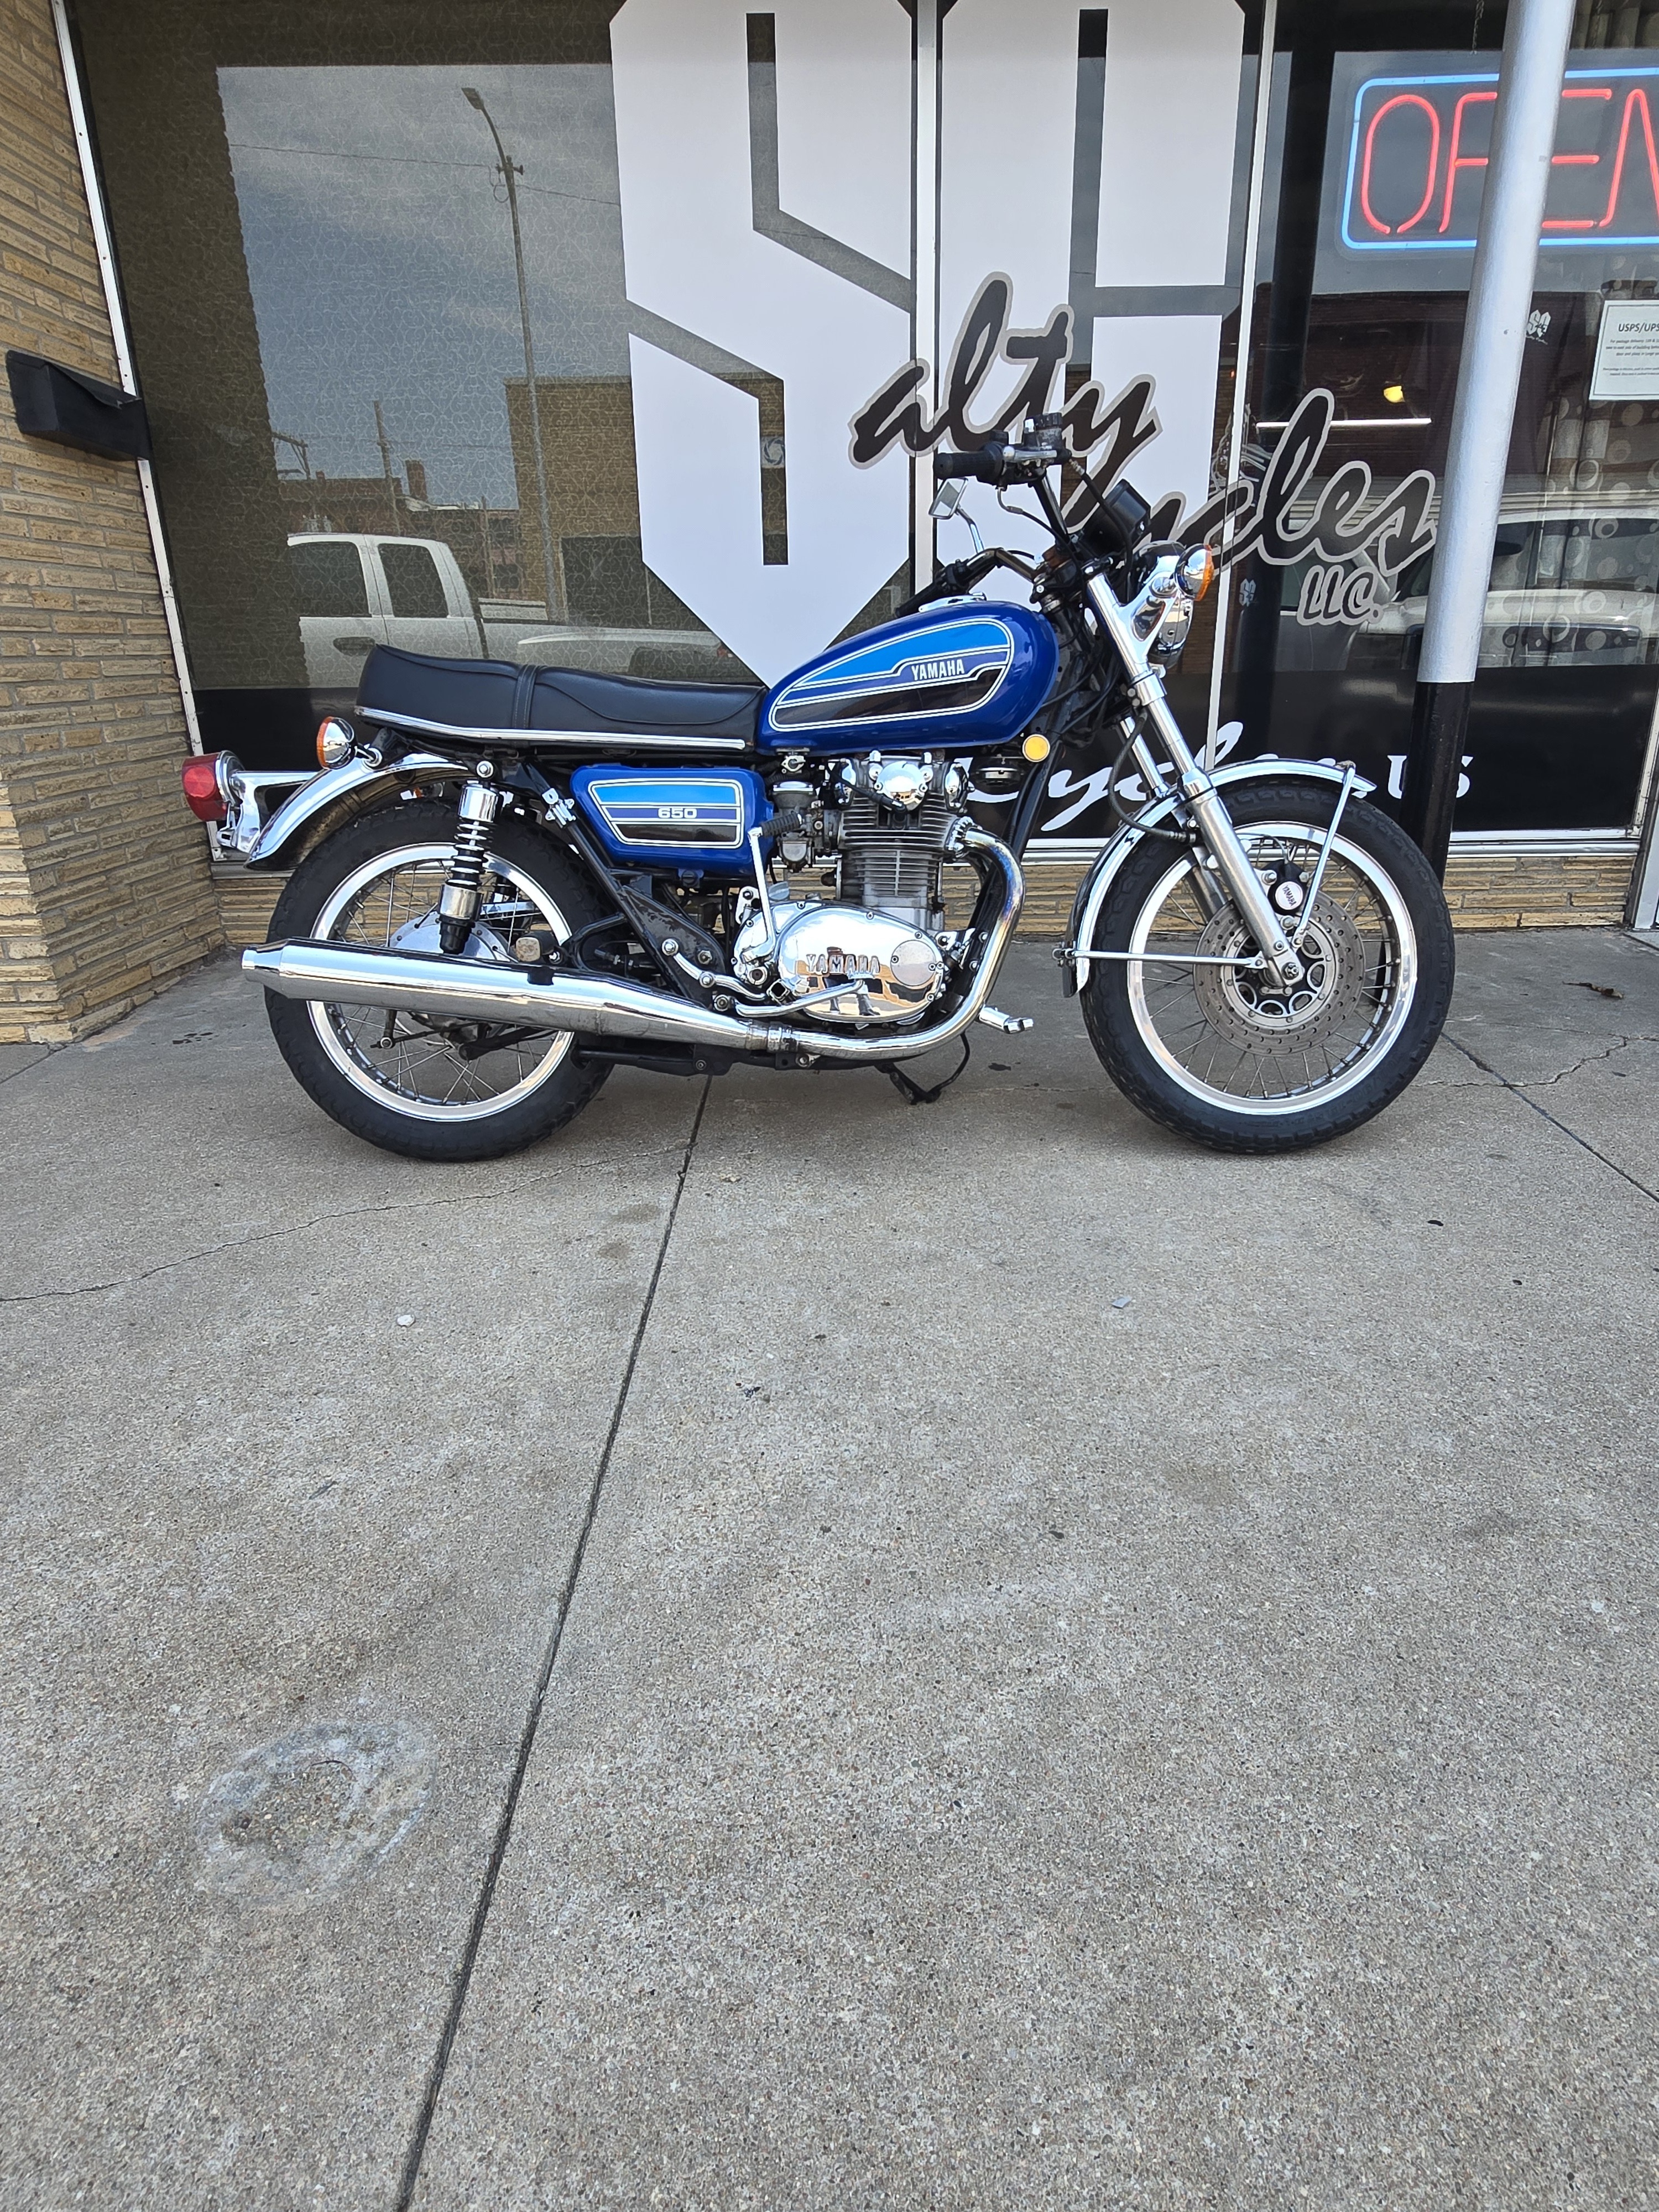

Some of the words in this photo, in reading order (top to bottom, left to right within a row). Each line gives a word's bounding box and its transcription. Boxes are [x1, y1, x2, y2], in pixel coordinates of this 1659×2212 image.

[911, 659, 965, 681] YAMAHA
[658, 807, 697, 819] 650
[1282, 885, 1297, 907] YAMAHA
[806, 953, 881, 975] YAMAHA
